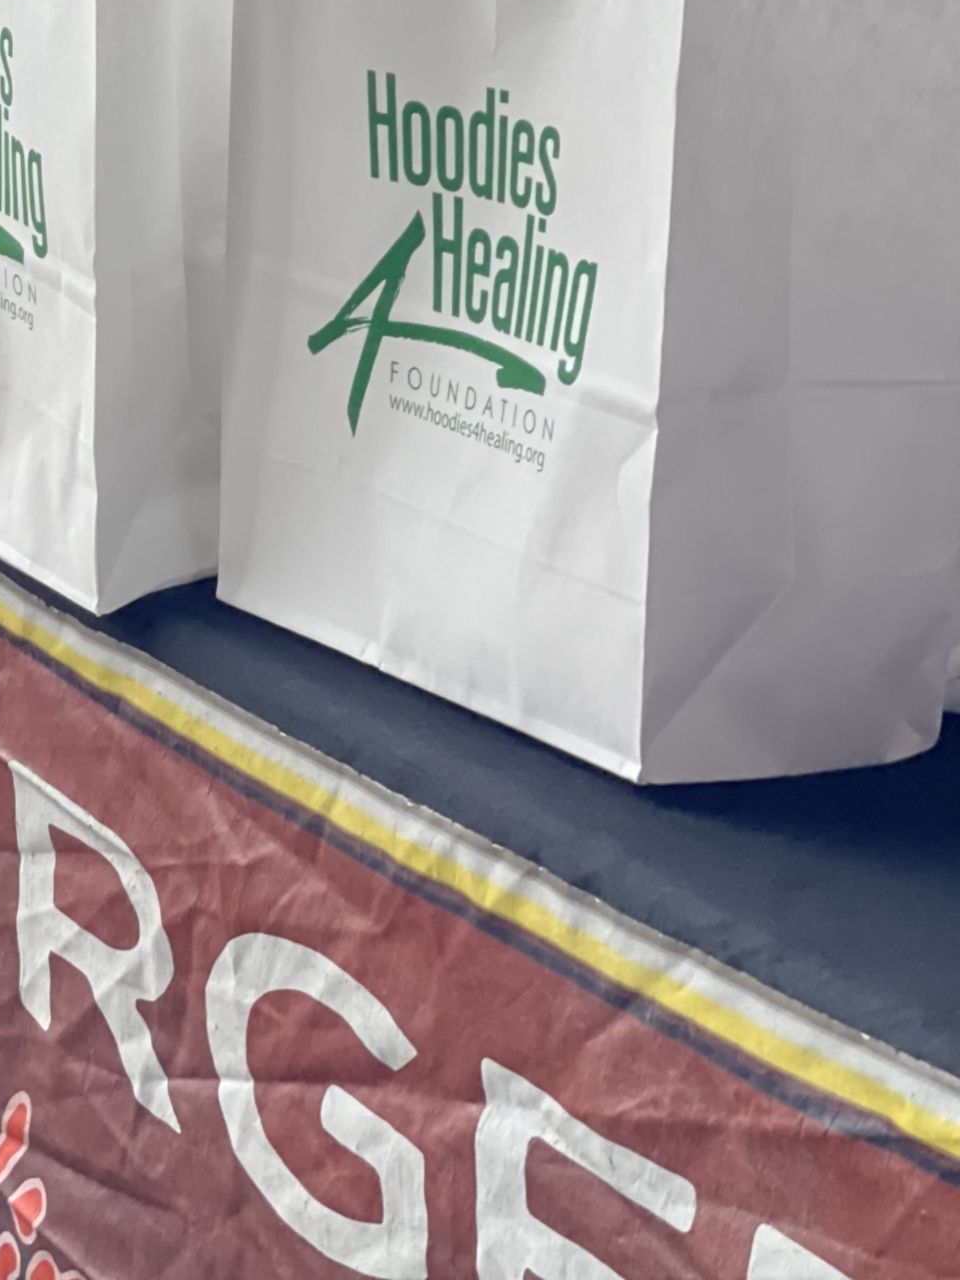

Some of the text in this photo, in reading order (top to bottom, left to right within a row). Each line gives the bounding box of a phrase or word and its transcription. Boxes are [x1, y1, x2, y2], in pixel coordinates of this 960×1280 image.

[366, 69, 561, 217] Hoodies
[307, 191, 599, 439] 4 Healing
[388, 393, 546, 473] www.hoodies4healing.org
[389, 360, 556, 442] FOUNDATION
